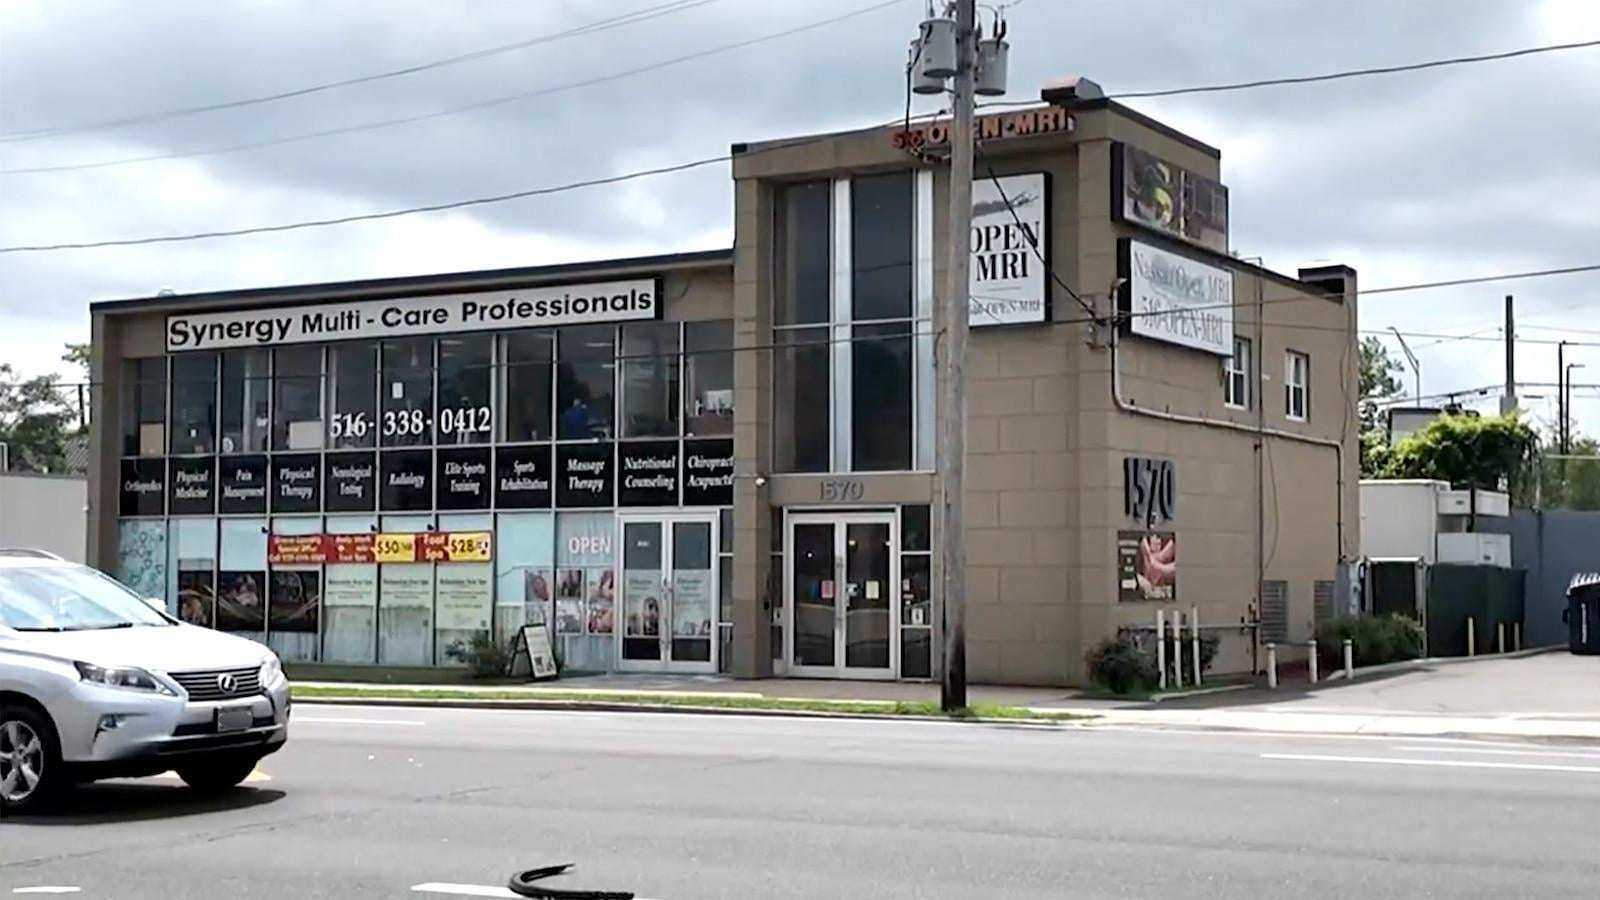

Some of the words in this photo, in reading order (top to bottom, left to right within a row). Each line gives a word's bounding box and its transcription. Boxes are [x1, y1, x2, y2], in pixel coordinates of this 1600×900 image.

[969, 221, 1040, 254] OPEN
[976, 251, 1029, 282] MRI
[1207, 274, 1231, 304] MRI
[169, 317, 293, 347] Synergy
[461, 289, 652, 322] Professionals
[462, 461, 486, 478] Sports
[513, 459, 536, 476] Sports
[566, 457, 605, 475] Massage
[623, 455, 676, 470] Nutritional
[175, 469, 209, 486] Physical
[235, 468, 253, 481] Pain
[280, 465, 315, 483] Physical
[388, 471, 425, 489] Radiology
[624, 474, 675, 491] Counseling
[175, 485, 209, 499] Medicine
[223, 485, 265, 500] Management
[281, 483, 313, 499] Therapy
[450, 479, 480, 495] Training
[569, 475, 604, 493] Therapy
[819, 479, 865, 501] 1570
[1122, 456, 1176, 528] 1570
[377, 539, 400, 555] $50
[451, 538, 475, 554] $28
[568, 536, 612, 554] OPEN
